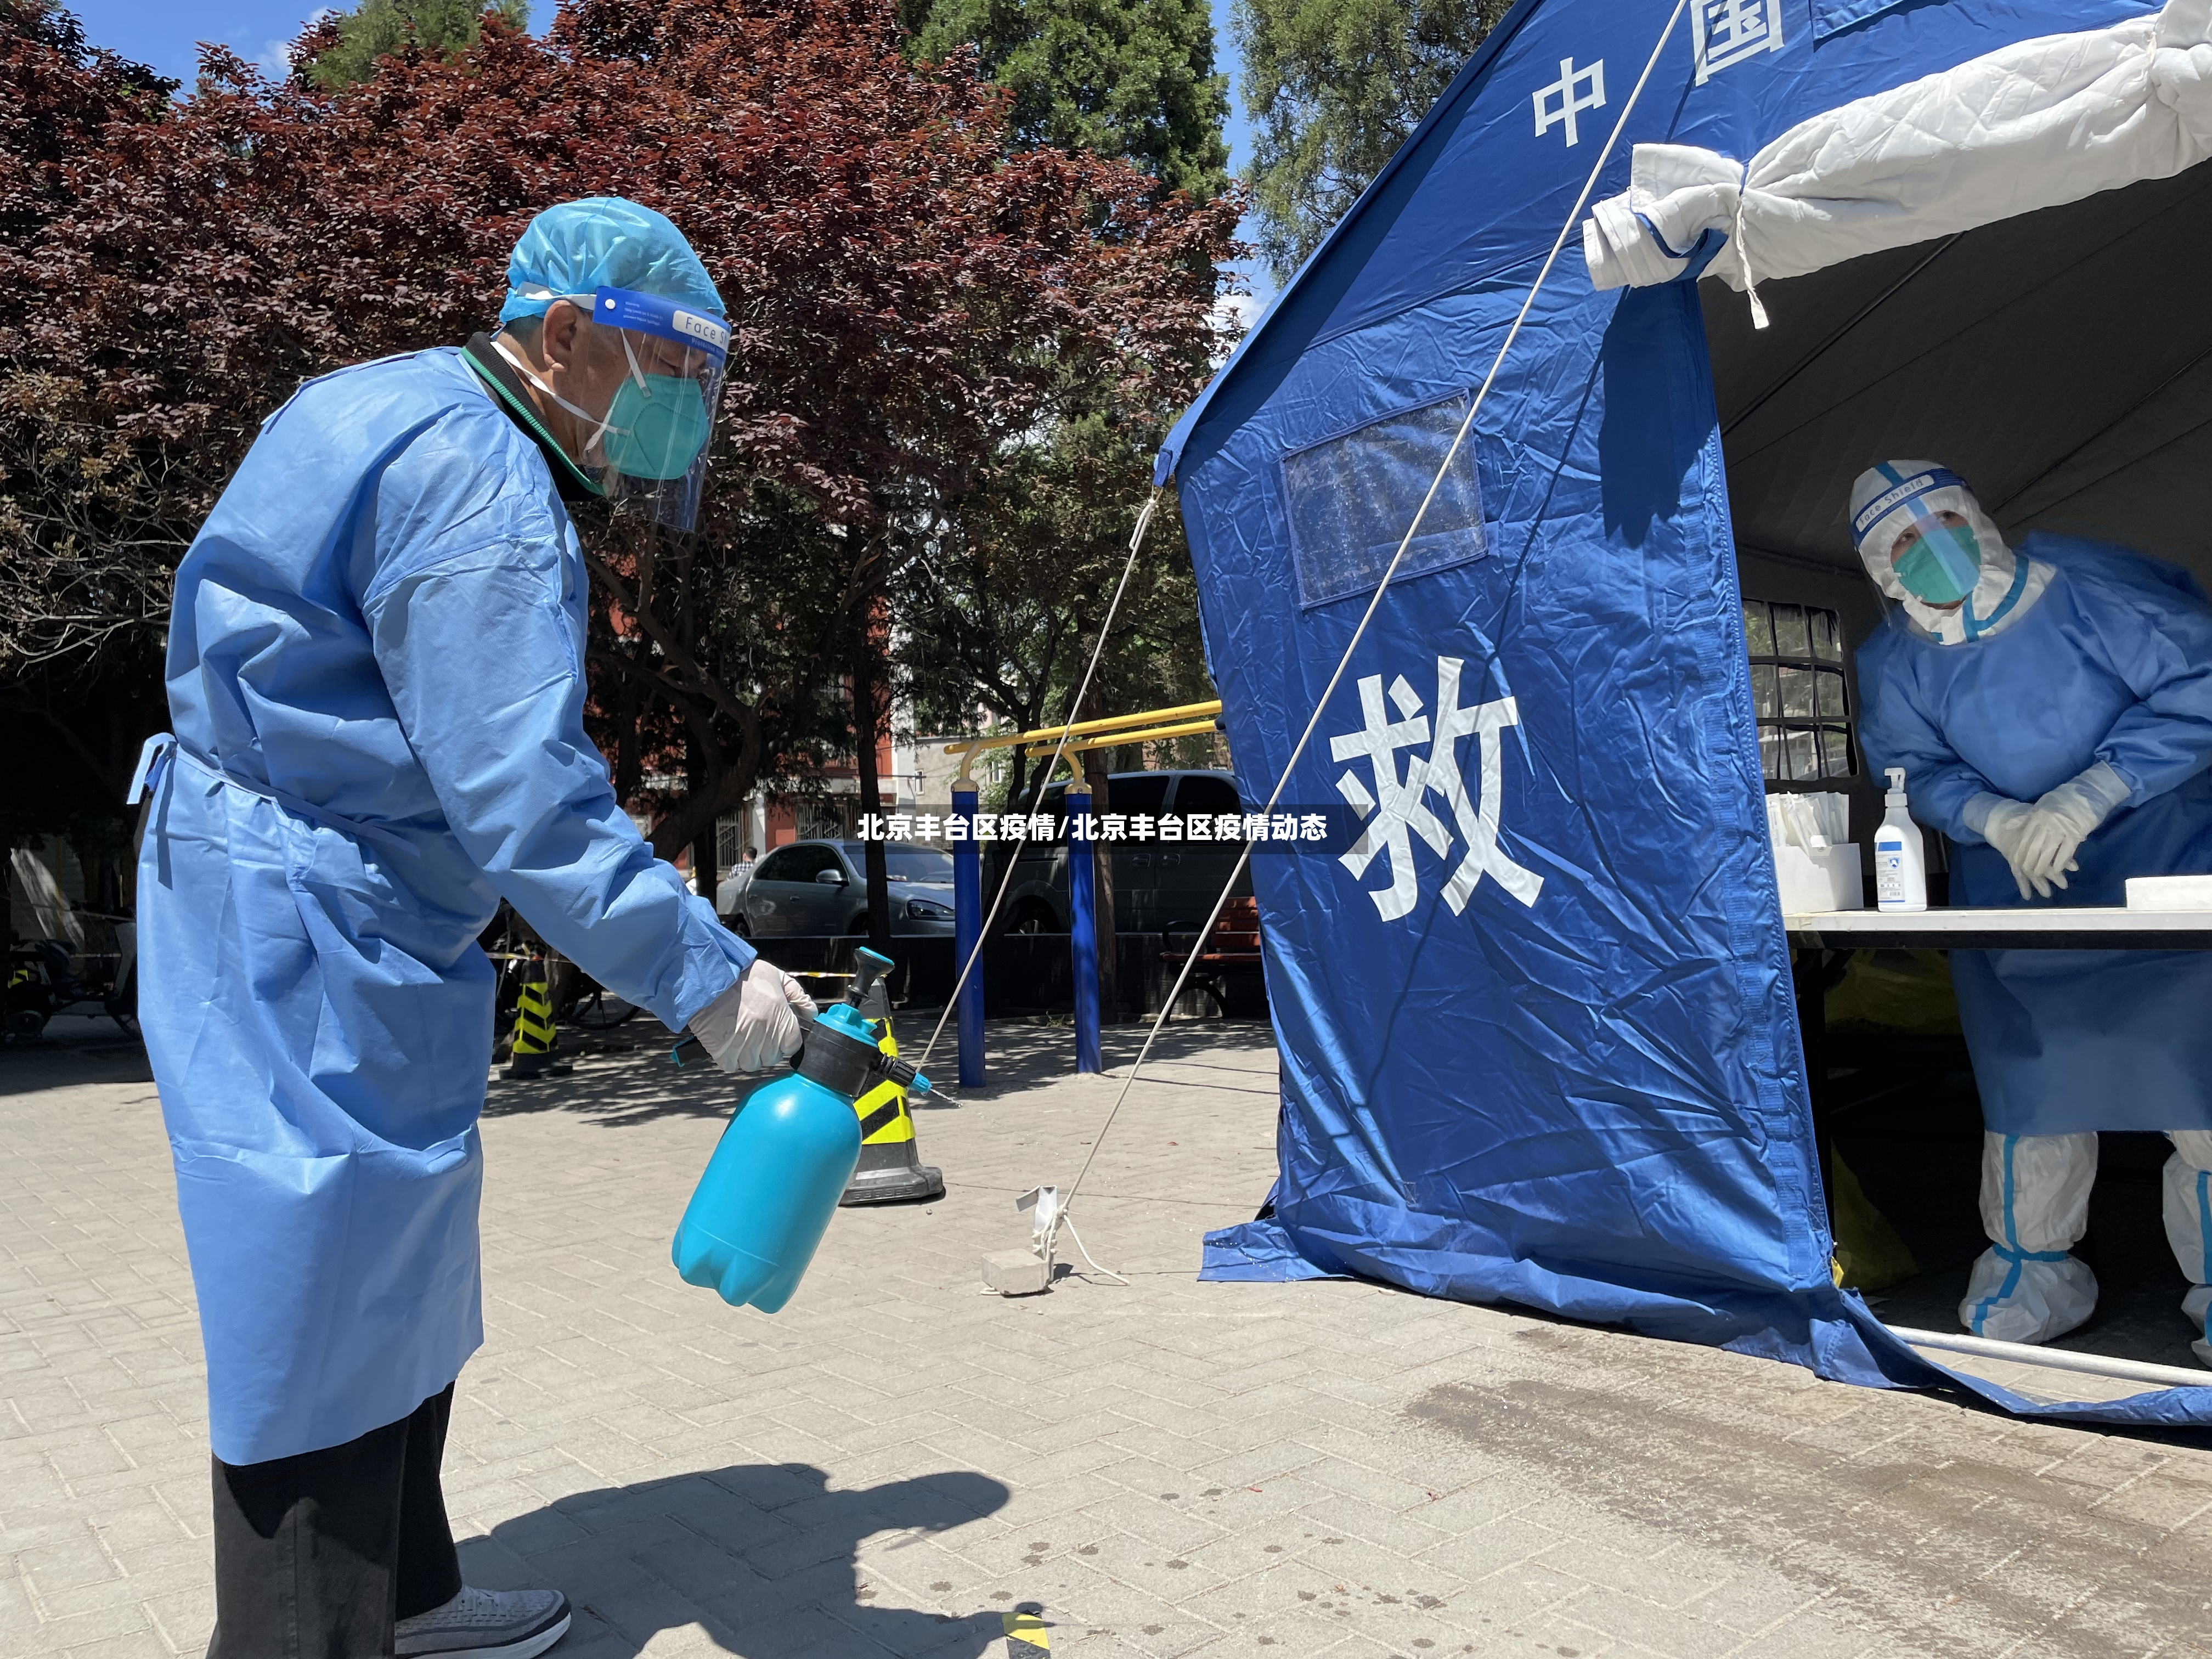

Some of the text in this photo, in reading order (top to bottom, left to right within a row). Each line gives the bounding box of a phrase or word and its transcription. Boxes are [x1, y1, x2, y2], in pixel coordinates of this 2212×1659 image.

[685, 317, 716, 339] Face
[1884, 478, 1924, 504] Shield
[1329, 655, 1545, 922] 救
